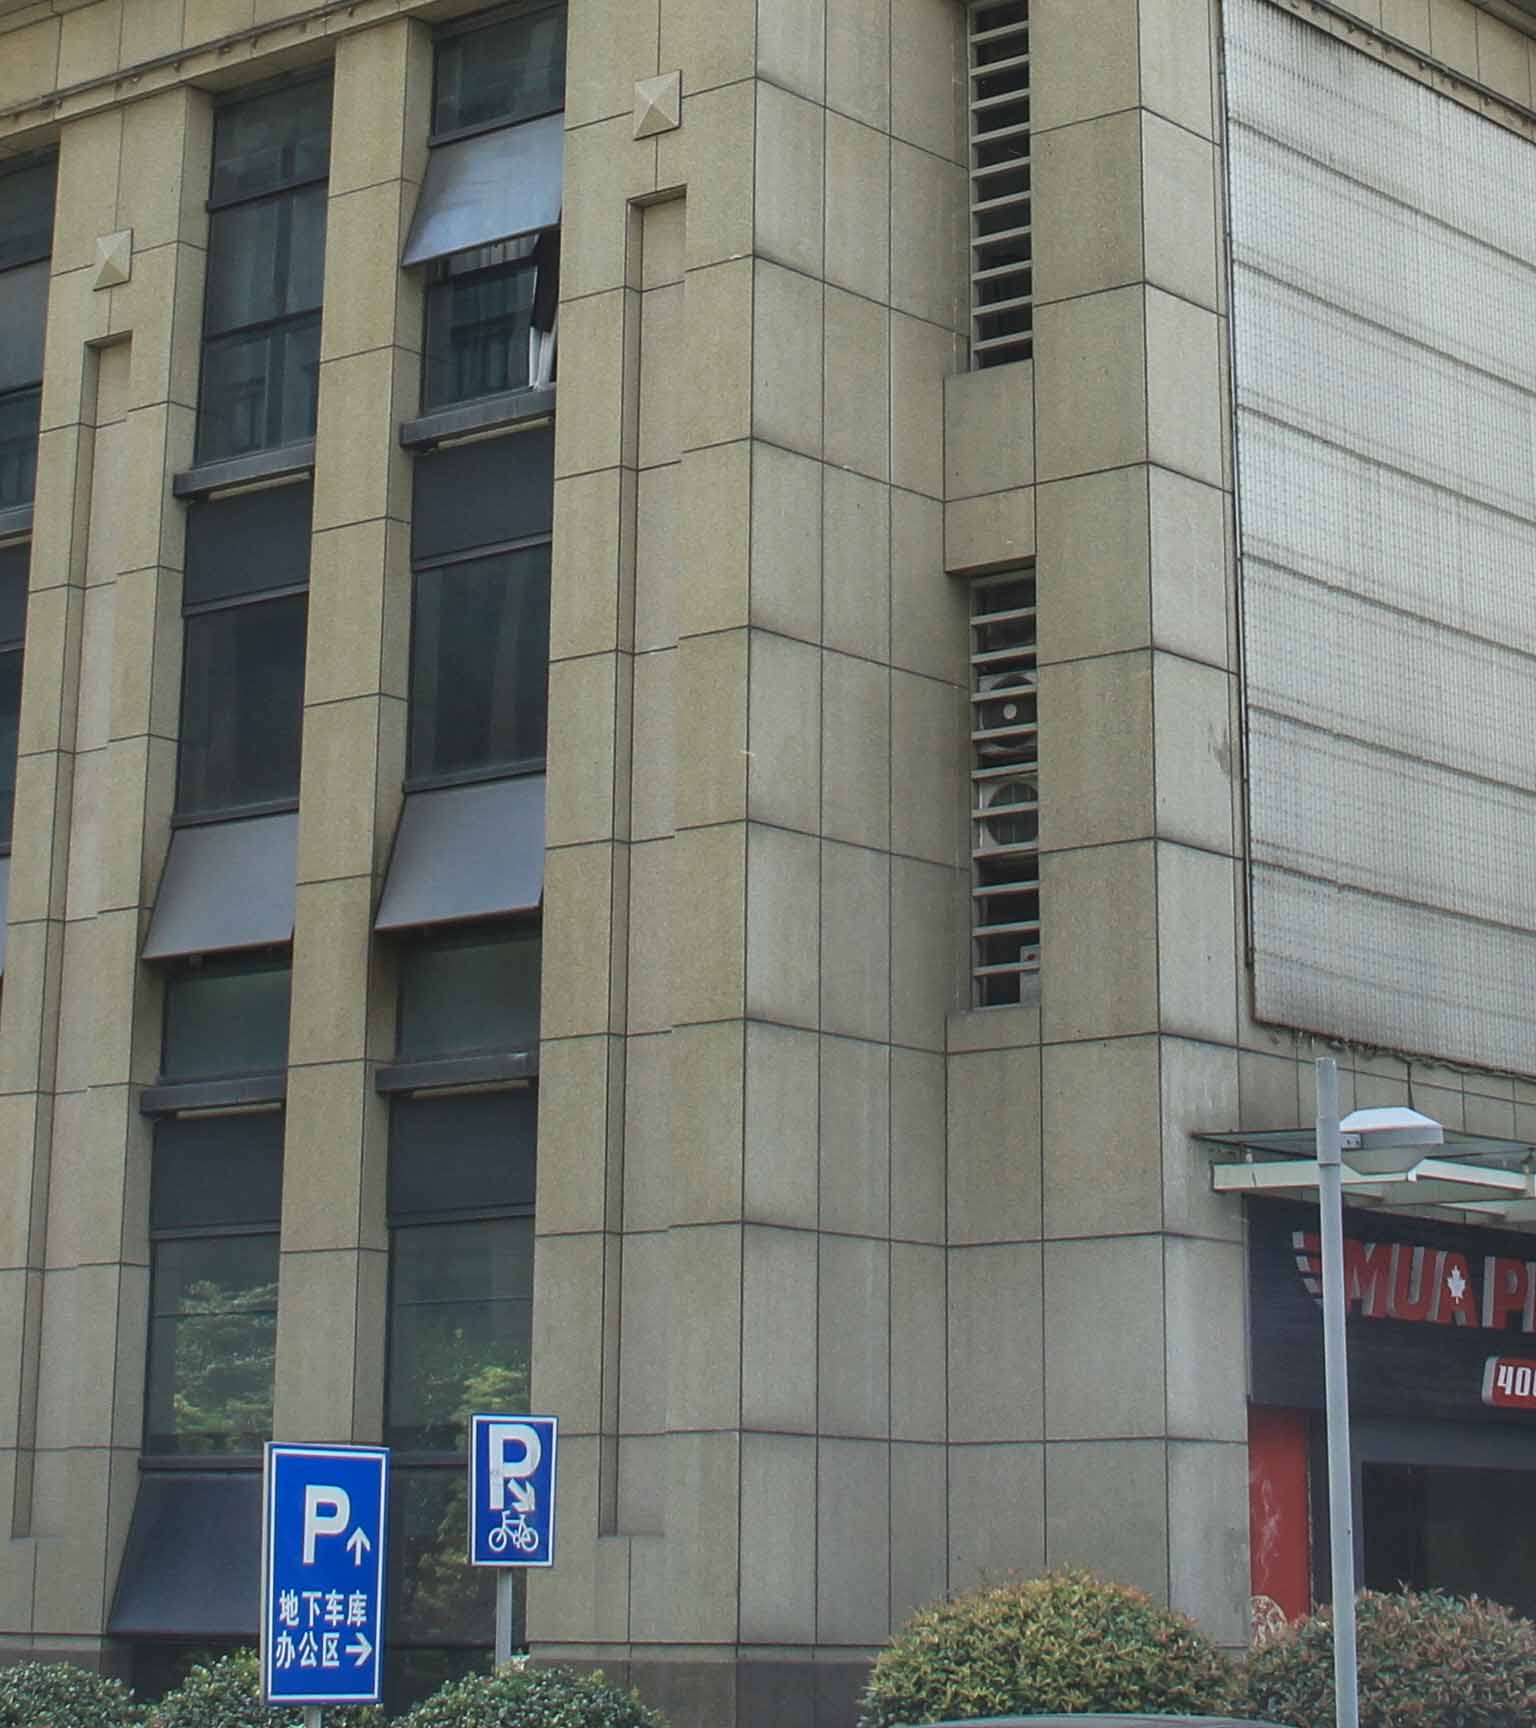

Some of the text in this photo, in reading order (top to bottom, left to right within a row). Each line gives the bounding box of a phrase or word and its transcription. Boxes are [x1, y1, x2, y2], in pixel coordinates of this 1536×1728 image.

[488, 1423, 542, 1511] P
[302, 1484, 351, 1566] P
[278, 1589, 368, 1628] 地下车库
[274, 1631, 341, 1670] 办公区
